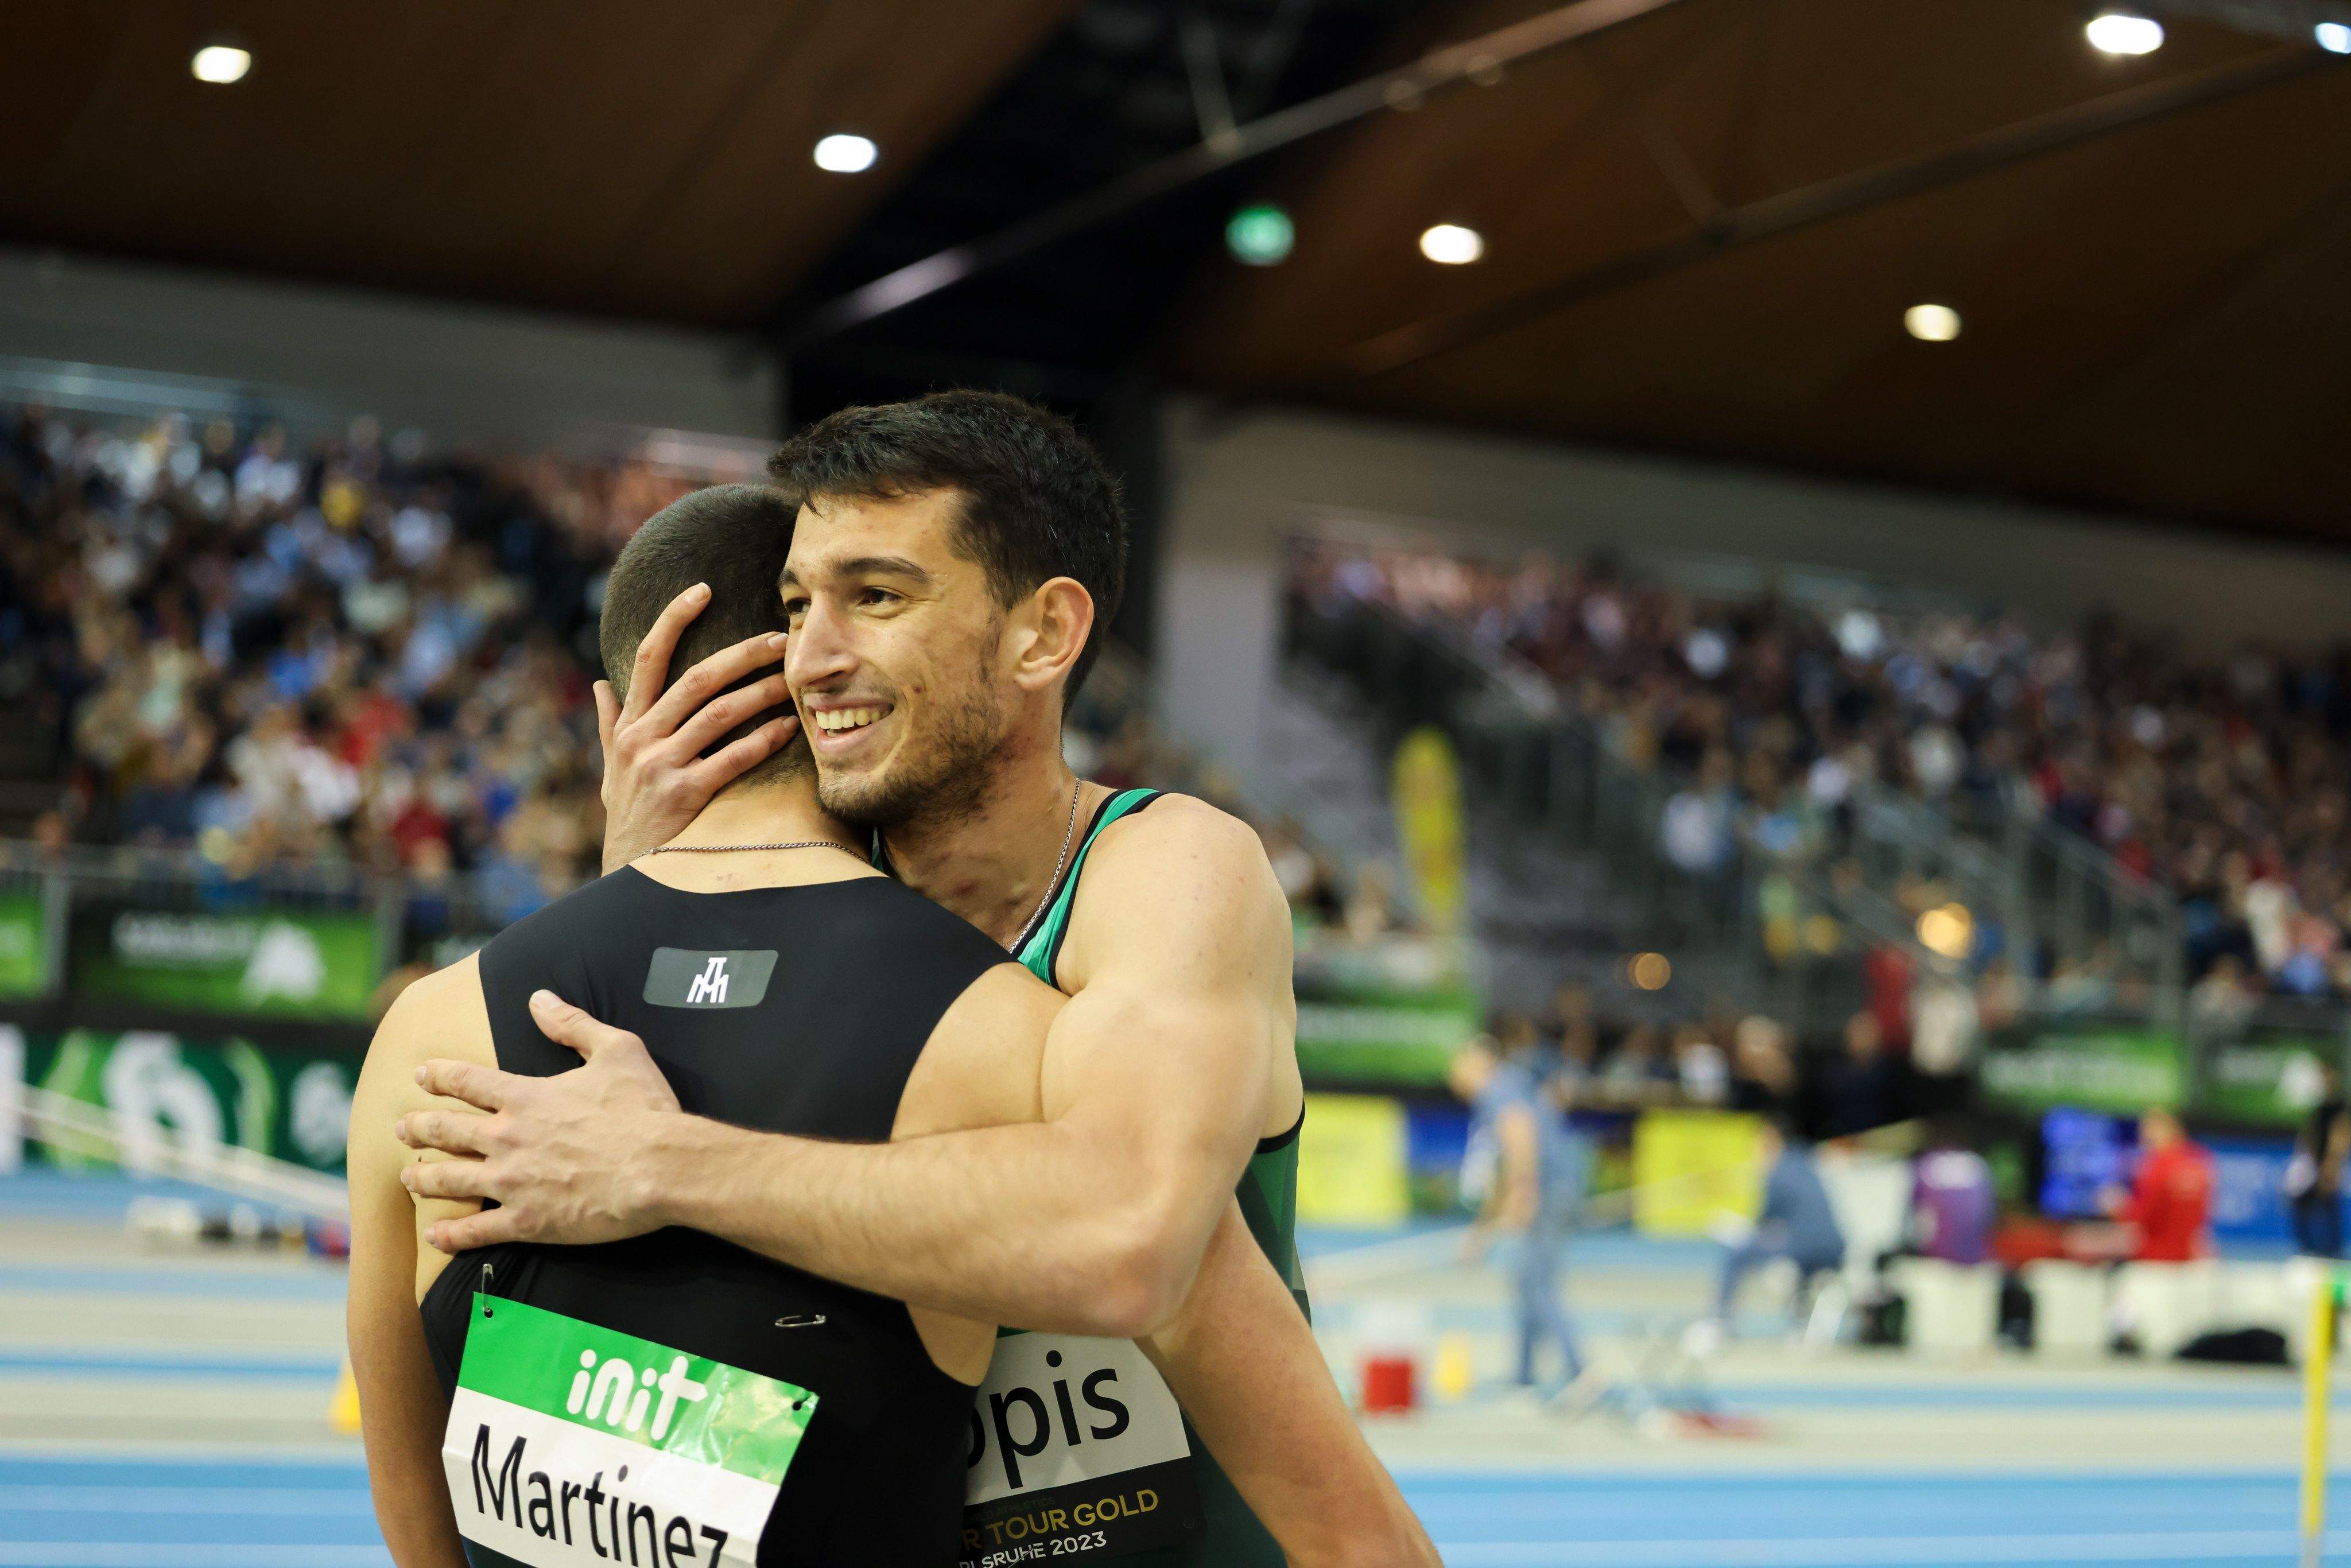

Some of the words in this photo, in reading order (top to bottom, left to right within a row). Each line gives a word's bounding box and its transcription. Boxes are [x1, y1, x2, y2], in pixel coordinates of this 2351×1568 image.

[566, 1349, 708, 1441] init
[471, 1423, 729, 1568] Martinez
[985, 1508, 1070, 1545] TOUR
[1073, 1488, 1159, 1527] GOLD
[1049, 1530, 1107, 1556] 2023
